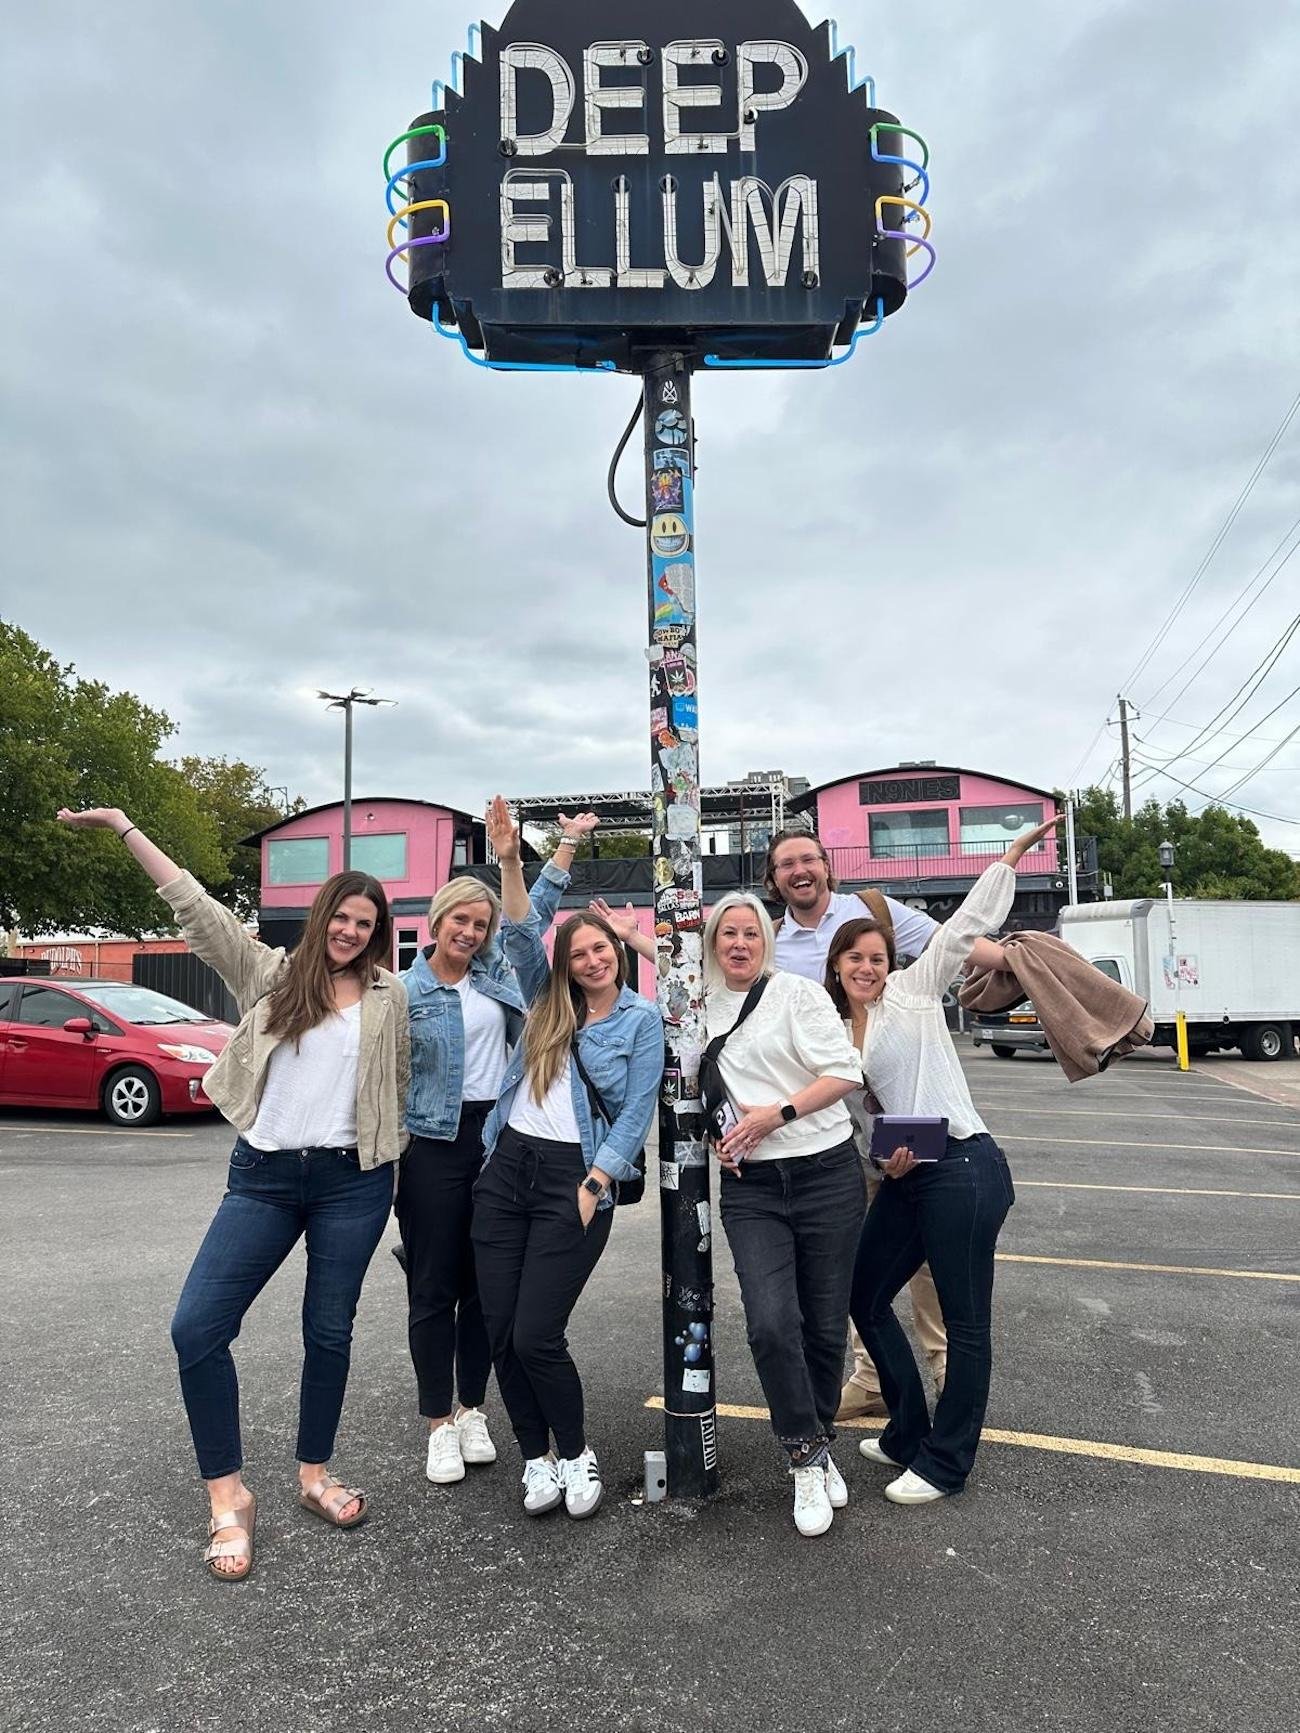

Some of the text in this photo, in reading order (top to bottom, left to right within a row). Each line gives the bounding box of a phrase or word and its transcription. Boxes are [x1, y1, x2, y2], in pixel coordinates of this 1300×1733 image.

[500, 40, 808, 155] DEEP
[500, 168, 820, 289] ELLUM
[675, 909, 700, 922] BARN
